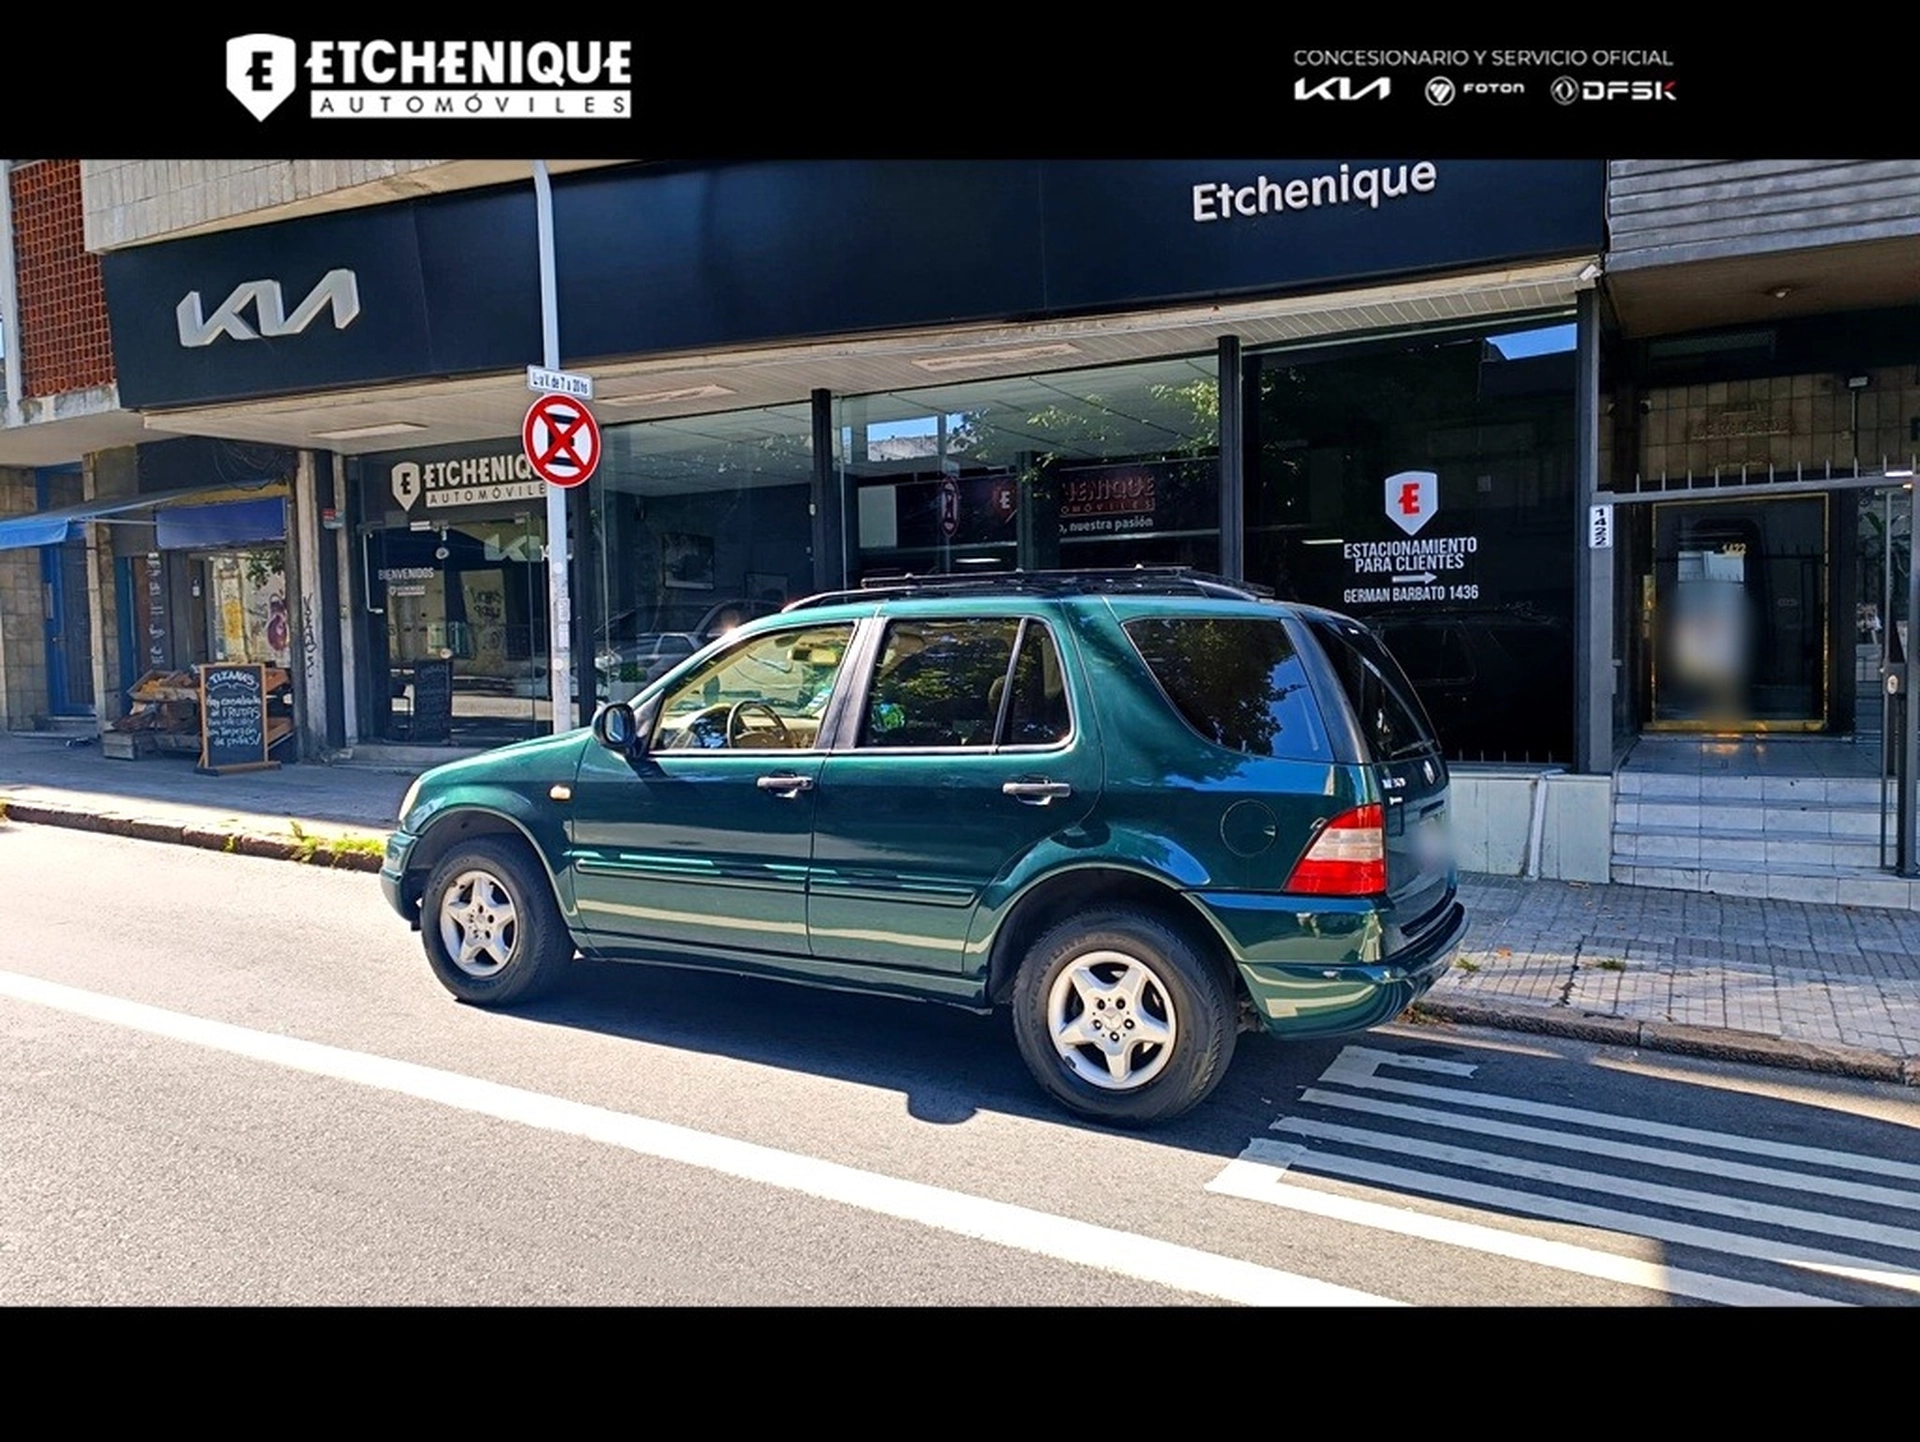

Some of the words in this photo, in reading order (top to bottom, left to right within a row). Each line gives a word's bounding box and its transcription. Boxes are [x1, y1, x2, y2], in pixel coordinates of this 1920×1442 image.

[1193, 160, 1437, 222] Etchenique
[176, 268, 360, 348] KIA
[423, 453, 537, 489] ETCHENIQ
[1069, 518, 1113, 532] nuestra
[1115, 515, 1154, 532] pasión
[1594, 507, 1607, 546] 1422
[1344, 537, 1478, 559] ESTACIONAMIENTO
[378, 567, 434, 580] BIENVENIDOS
[1355, 557, 1392, 573] PARA
[1396, 553, 1465, 572] CLIENTES
[1344, 588, 1391, 603] GERMAN
[1393, 586, 1446, 602] BARBATO
[1449, 584, 1479, 600] 1436
